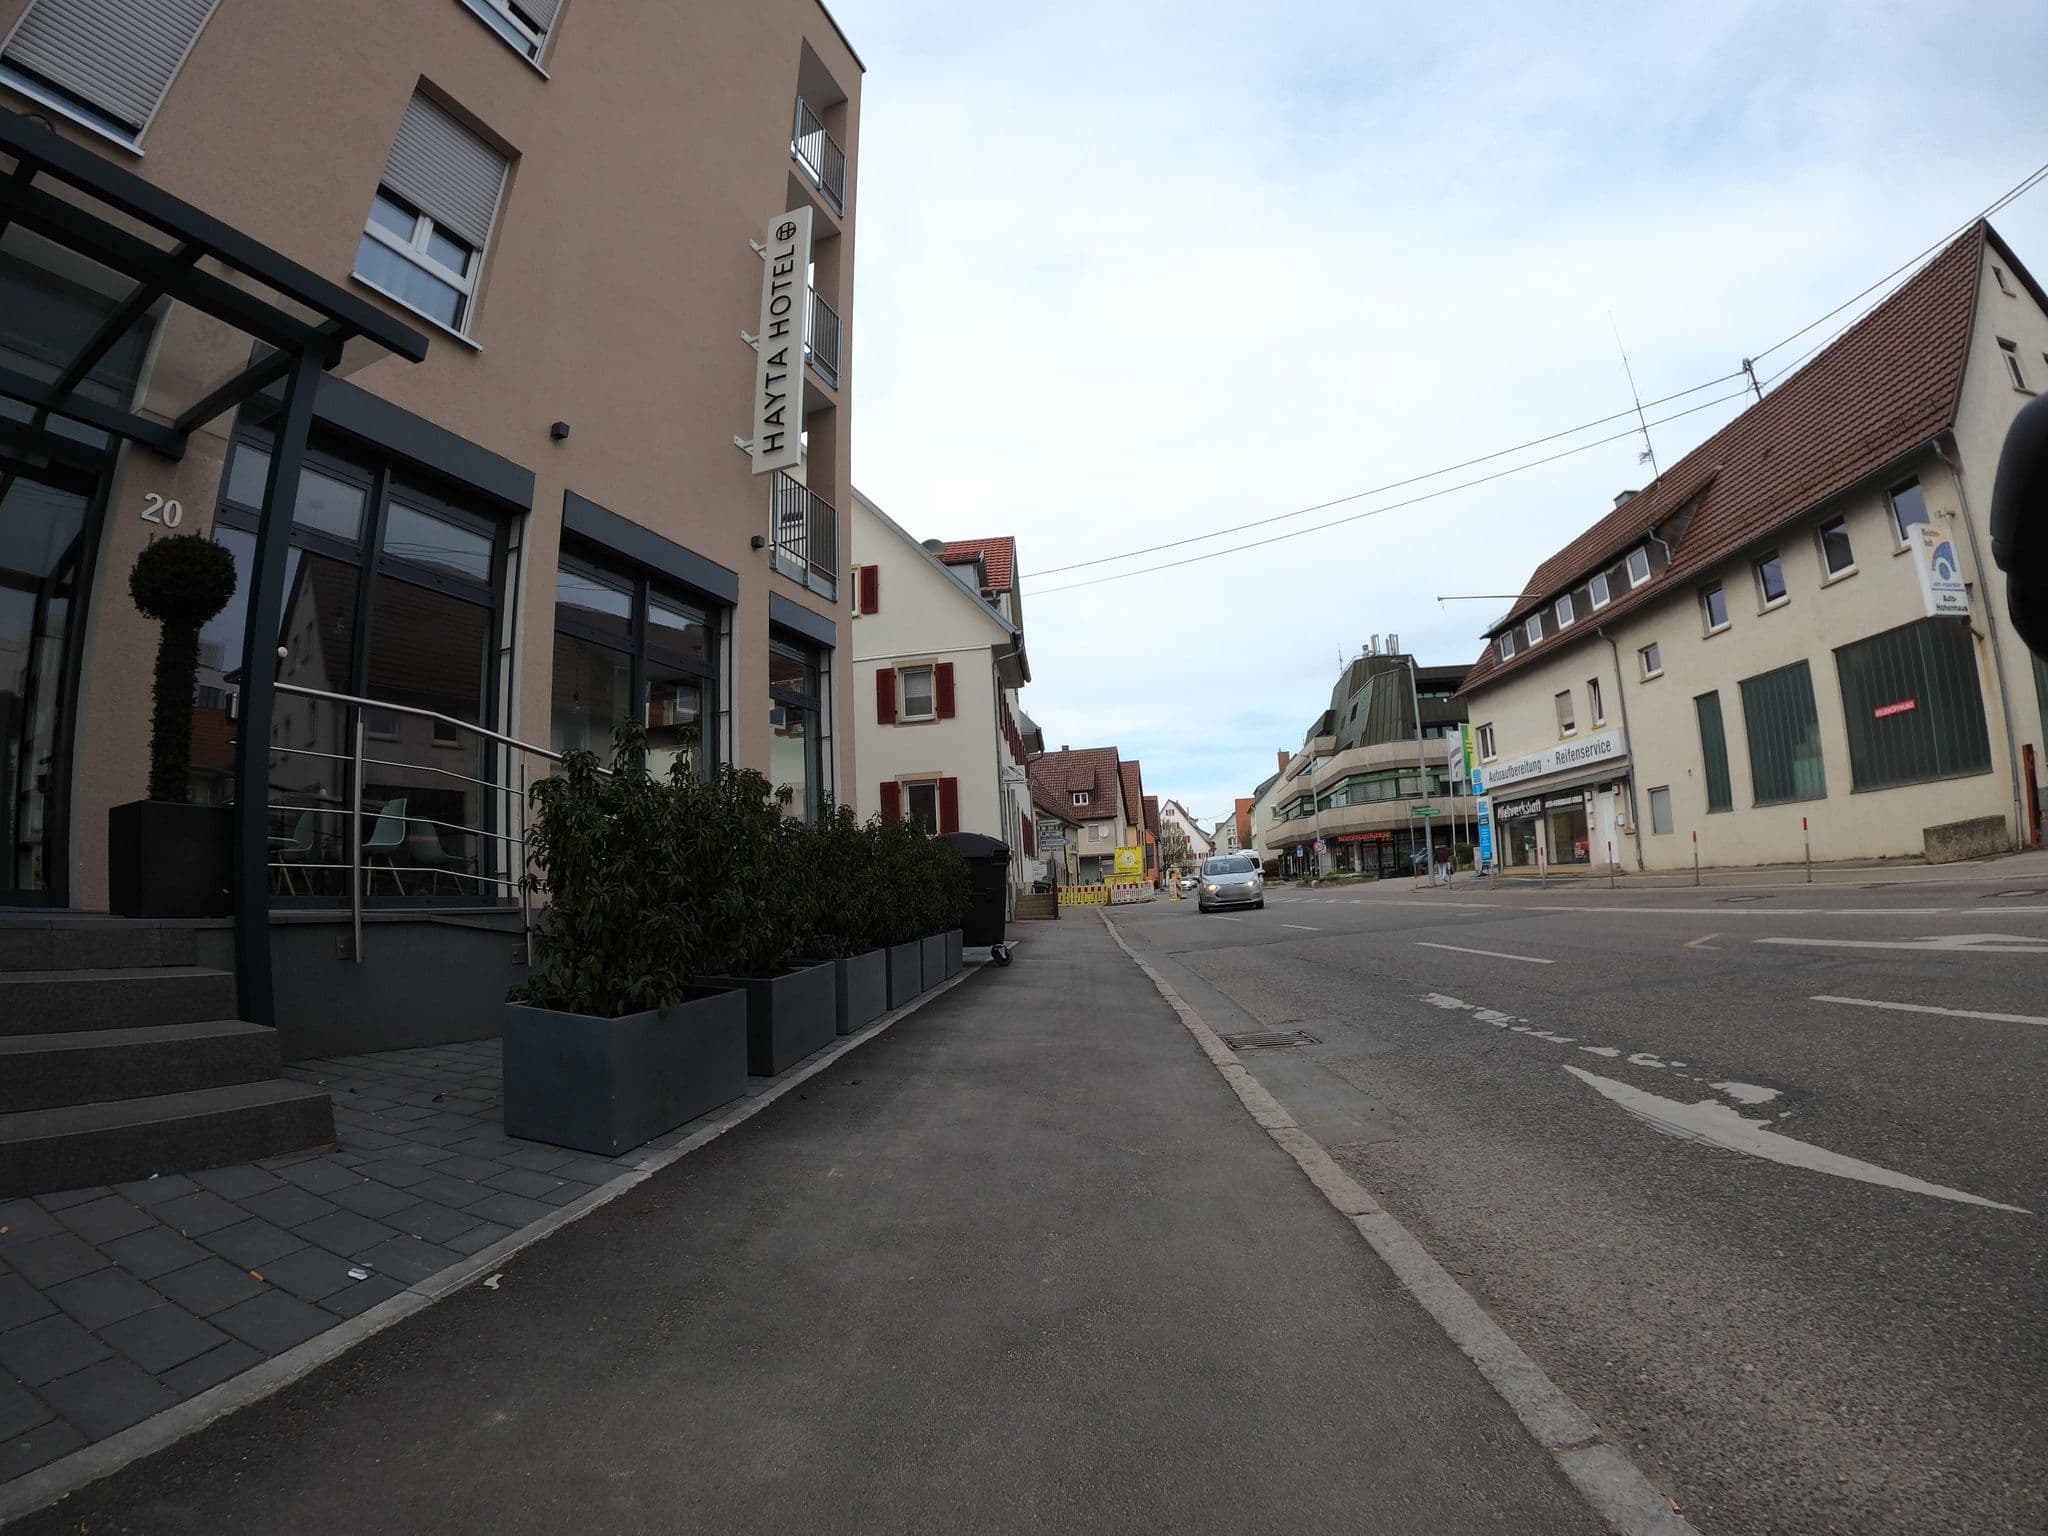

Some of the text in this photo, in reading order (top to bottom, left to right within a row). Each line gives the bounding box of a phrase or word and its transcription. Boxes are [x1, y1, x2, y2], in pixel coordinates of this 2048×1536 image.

[763, 244, 795, 454] HAYTA HOTEL
[141, 492, 183, 528] 20
[1488, 757, 1542, 784] Autoaufbereitung
[1555, 739, 1611, 765] Reifenservice
